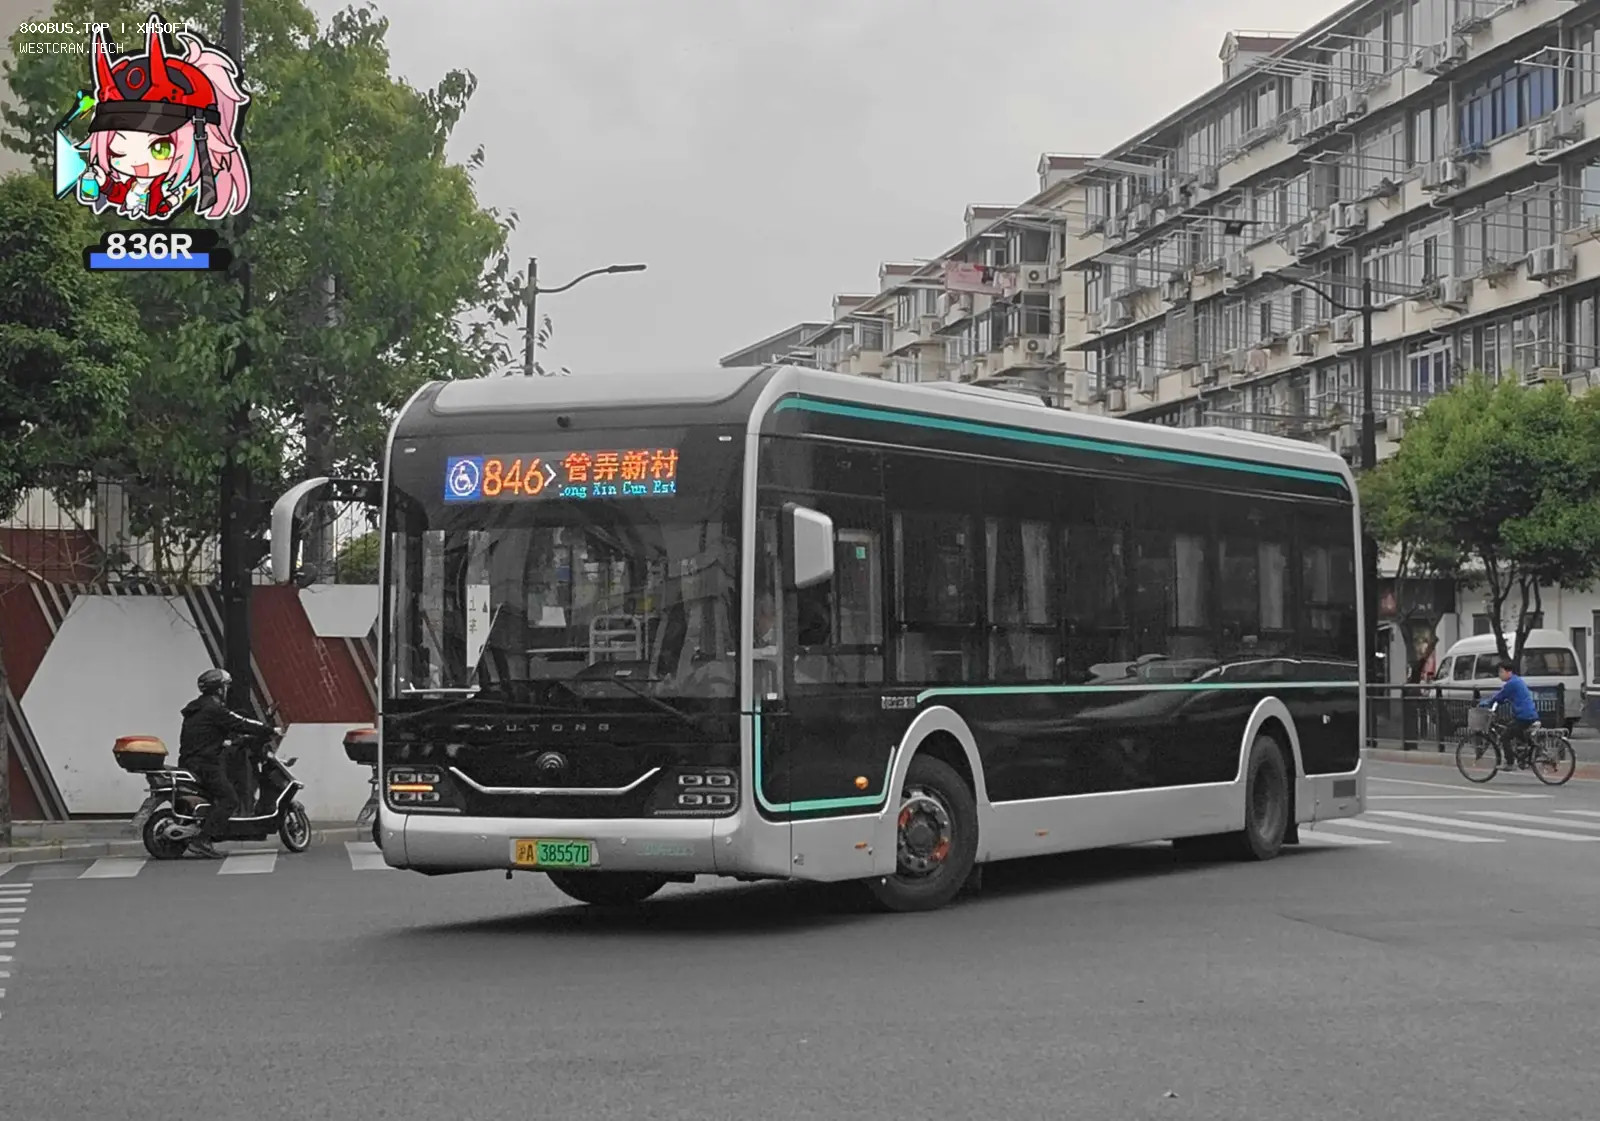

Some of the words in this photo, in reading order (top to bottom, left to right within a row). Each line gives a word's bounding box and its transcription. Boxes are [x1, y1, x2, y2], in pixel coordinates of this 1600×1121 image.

[483, 458, 545, 496] 846
[564, 448, 679, 482] 管弄新村
[622, 480, 647, 495] Cun
